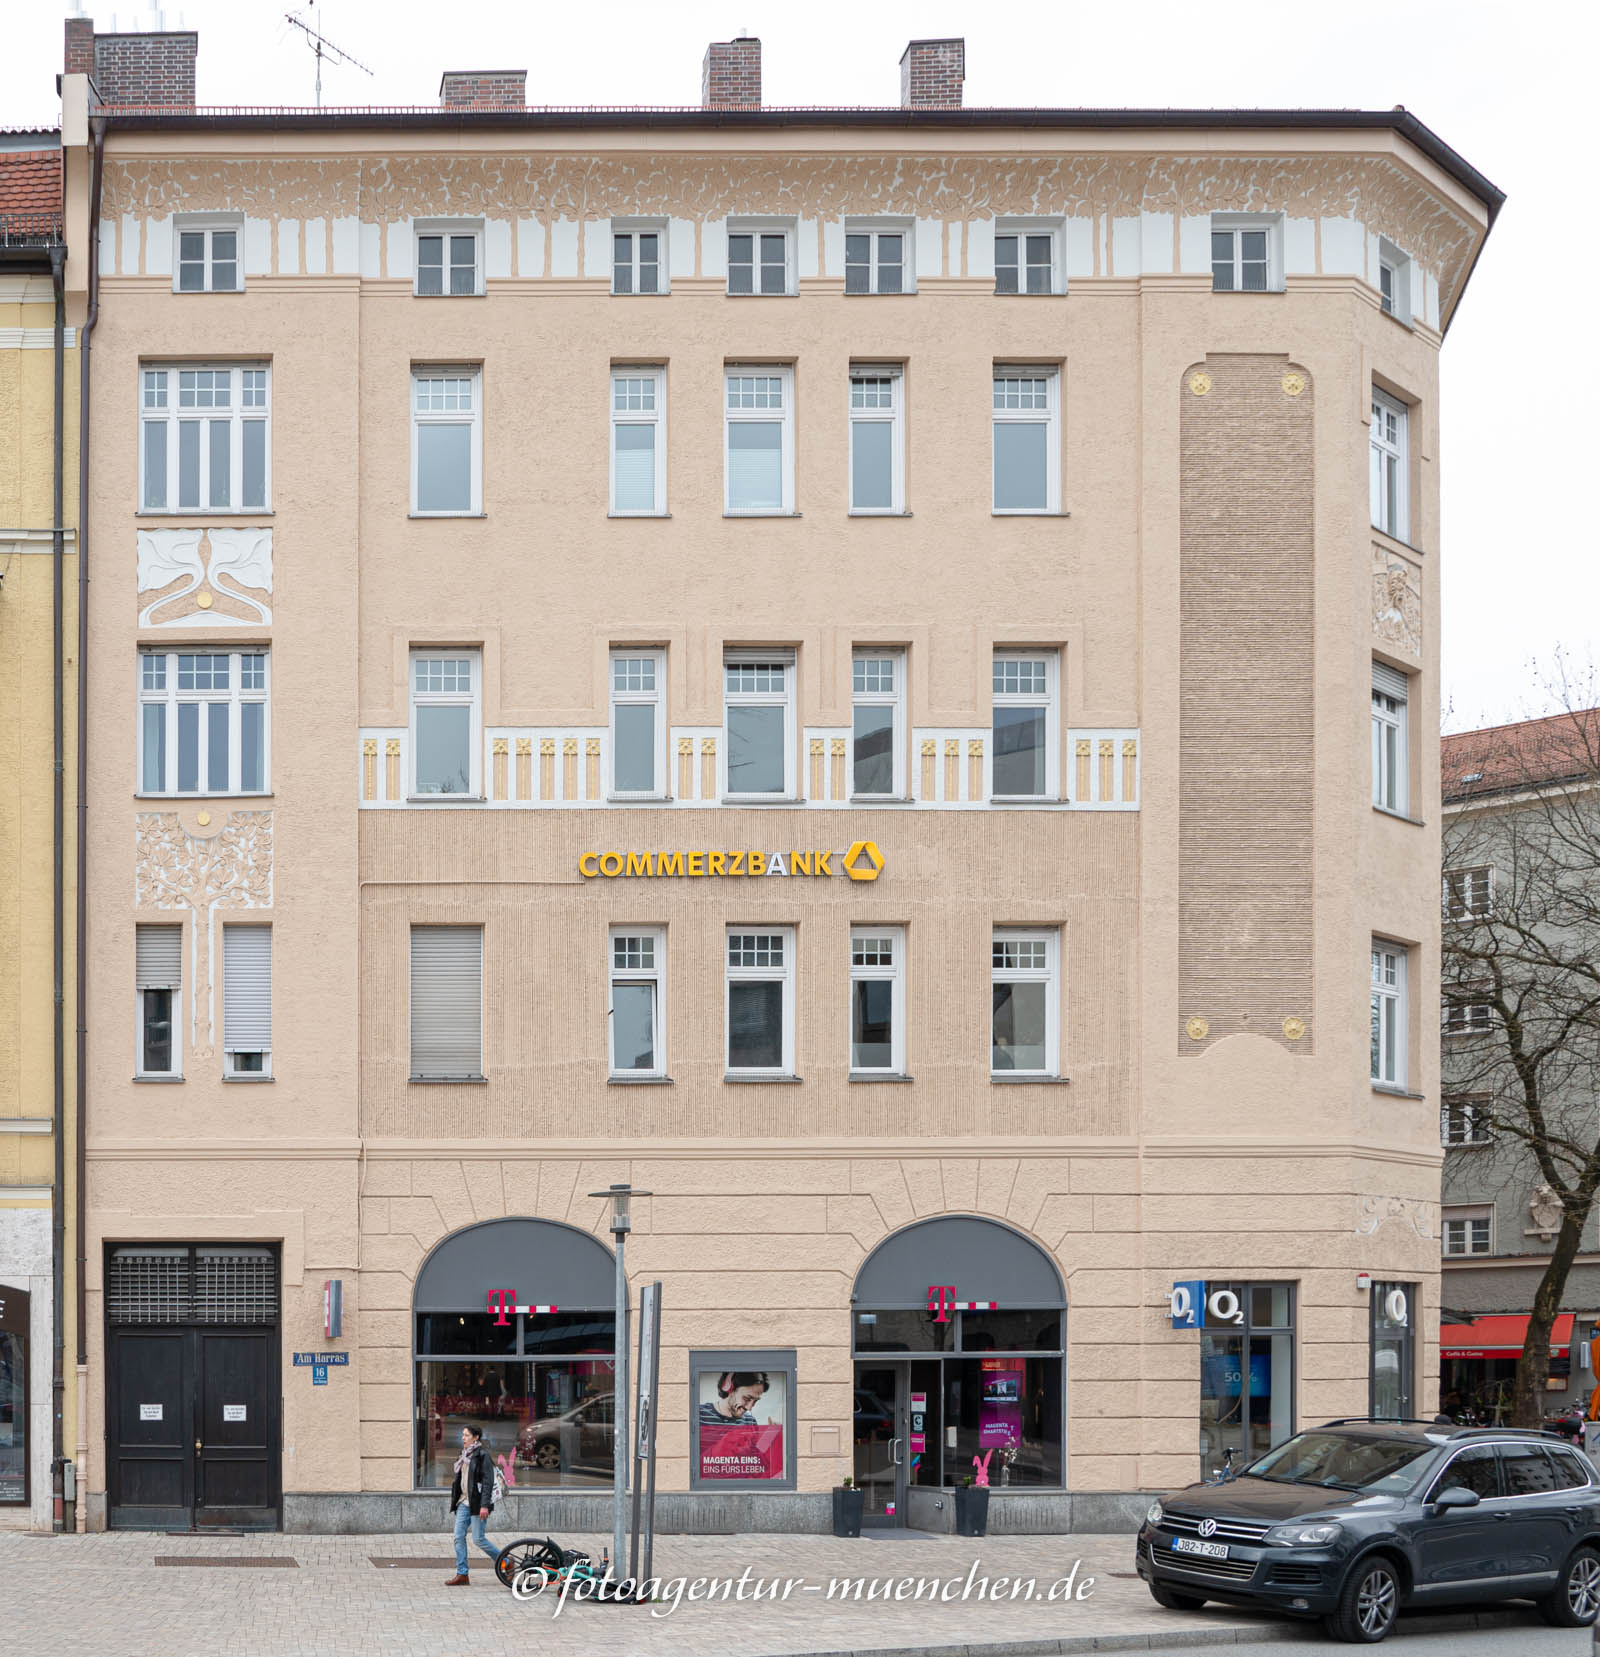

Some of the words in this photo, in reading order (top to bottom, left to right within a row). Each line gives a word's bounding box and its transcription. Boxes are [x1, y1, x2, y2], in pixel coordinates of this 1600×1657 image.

[579, 850, 833, 877] COMMERZBANK
[488, 1289, 517, 1326] T
[928, 1286, 956, 1323] T
[297, 1354, 312, 1363] Am
[314, 1354, 345, 1363] Harras
[316, 1367, 325, 1377] 16
[703, 1456, 739, 1464] MAGENTA
[740, 1456, 761, 1464] EINS:
[703, 1465, 720, 1474] EINS
[721, 1464, 740, 1474] FÜRS
[741, 1465, 765, 1474] LEBEN
[1178, 1540, 1227, 1557] J82-T-208
